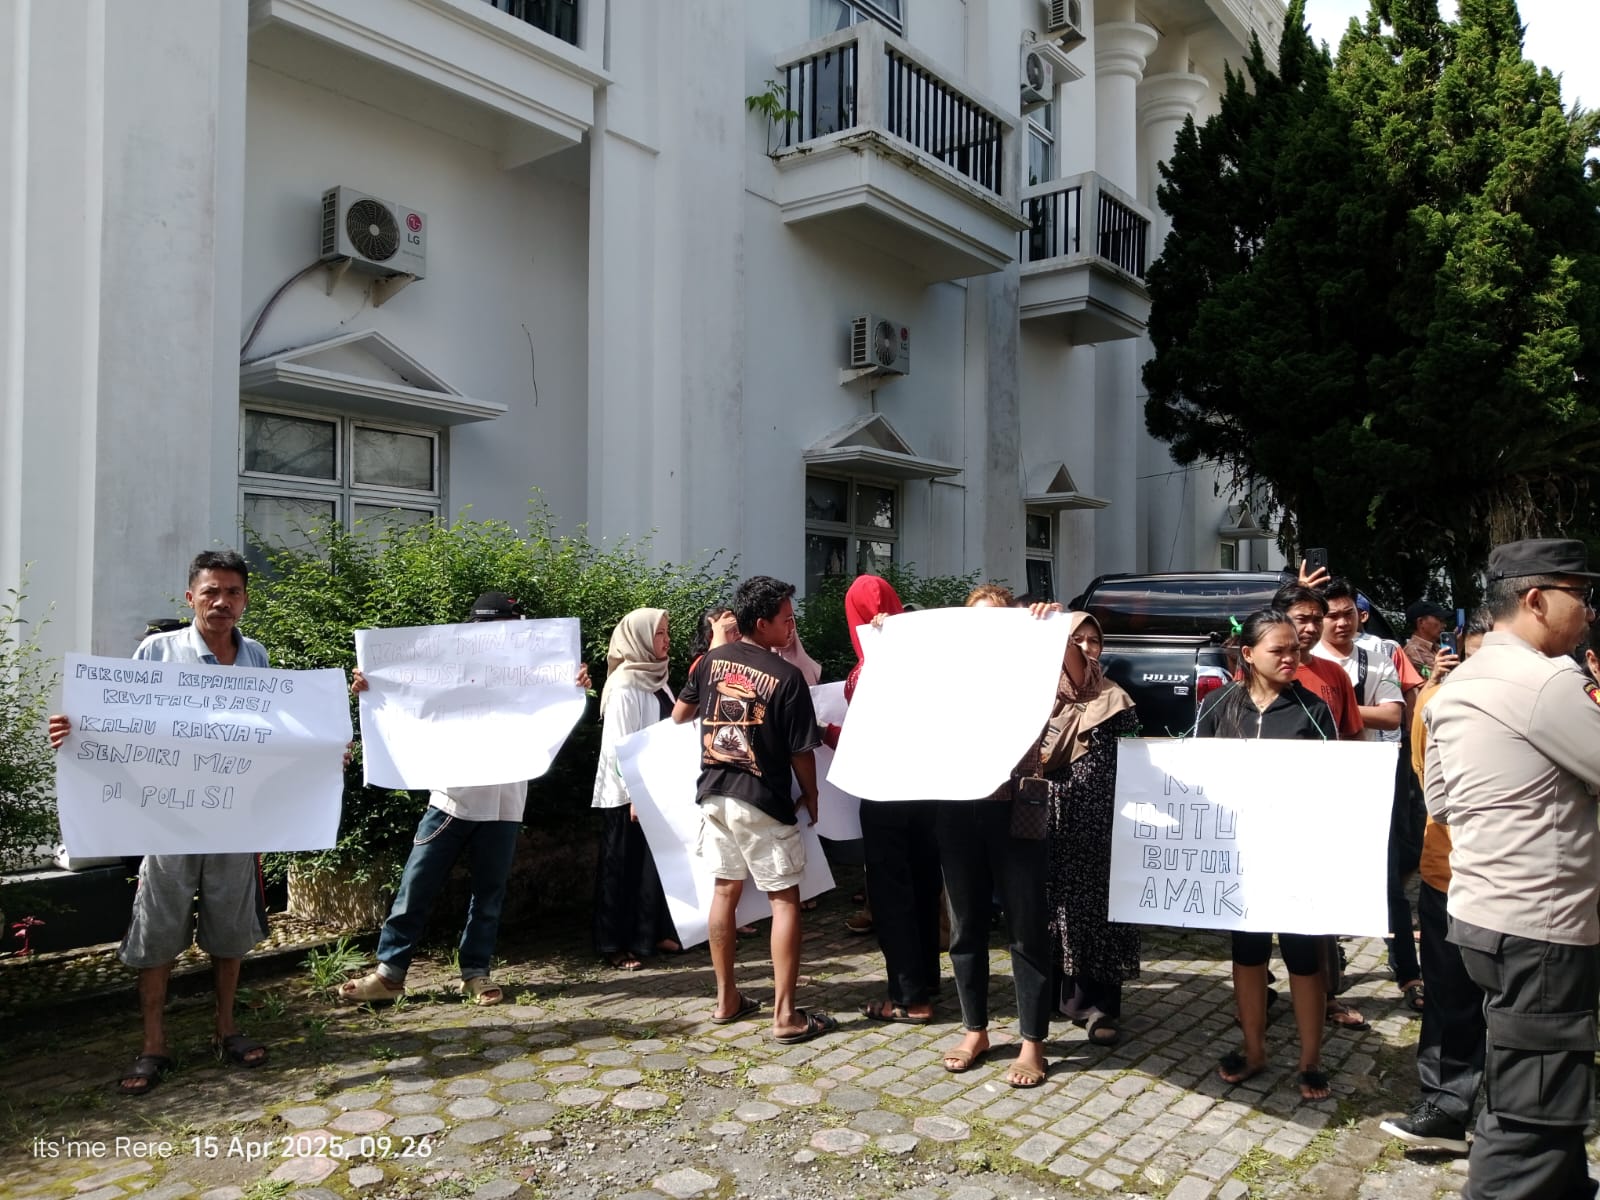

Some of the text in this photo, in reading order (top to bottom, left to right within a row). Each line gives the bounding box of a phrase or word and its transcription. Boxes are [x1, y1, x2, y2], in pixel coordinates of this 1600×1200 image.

[408, 234, 419, 245] LG
[456, 631, 545, 656] MINTA
[76, 663, 294, 694] PERCUMA KEPAHIANG
[485, 663, 576, 688] BUKAN
[708, 659, 780, 704] PERFECTION
[1142, 673, 1190, 684] HILUX
[80, 715, 272, 743] KALAU RAKYAT
[77, 741, 252, 774] SENDIRI MAU
[102, 782, 234, 810] DI POLISI
[1133, 802, 1238, 840] BUTU
